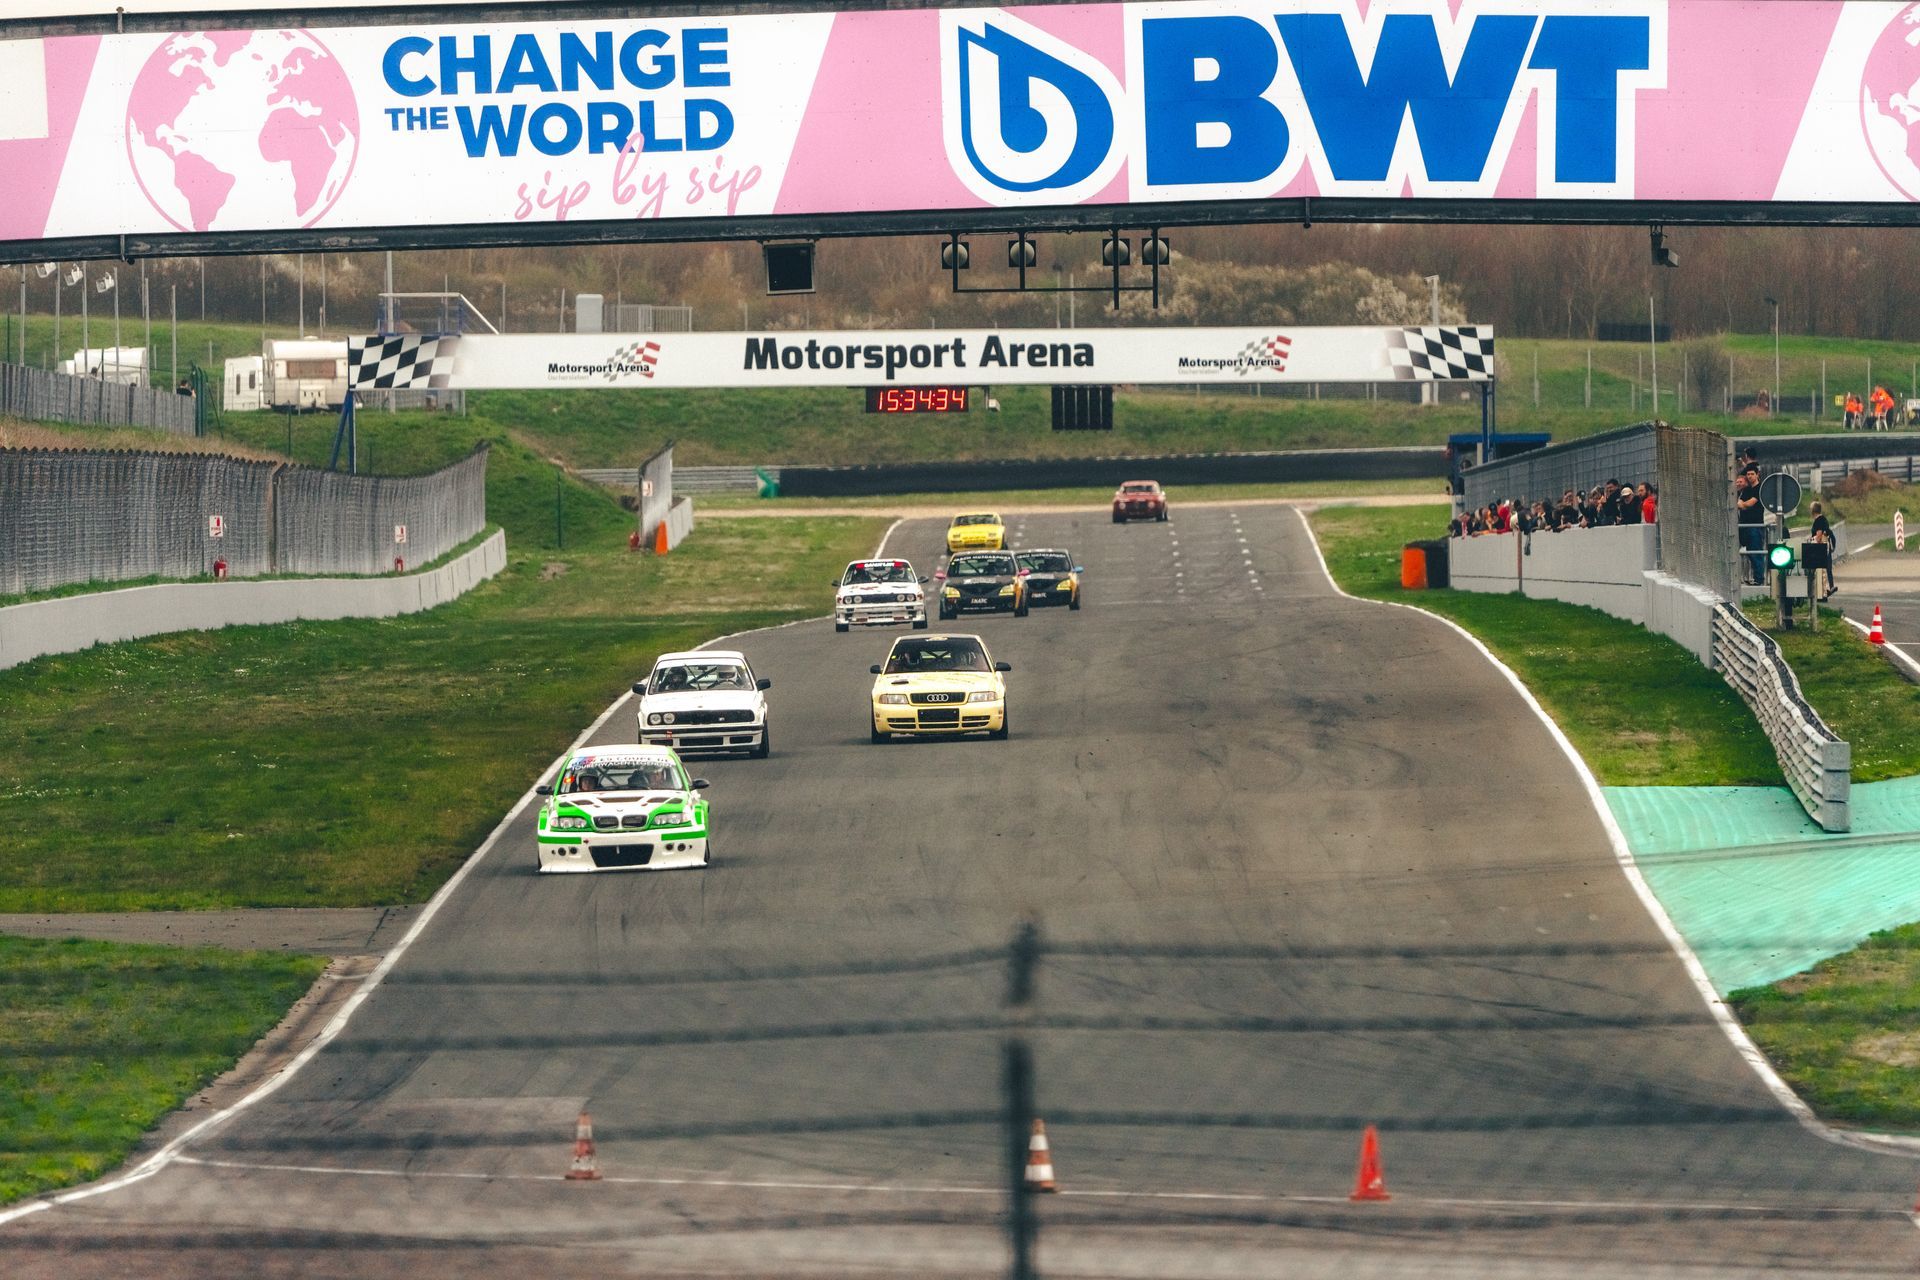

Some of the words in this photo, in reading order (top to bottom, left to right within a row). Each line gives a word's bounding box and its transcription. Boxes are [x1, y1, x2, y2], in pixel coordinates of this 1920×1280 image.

[382, 27, 731, 97] CHANGE
[1143, 13, 1650, 186] BWT
[384, 106, 449, 131] THE
[454, 98, 735, 158] WORLD
[514, 170, 591, 221] sip
[612, 132, 670, 219] by
[686, 155, 762, 216] sip
[548, 363, 613, 375] Motorsport
[616, 362, 650, 373] Arena
[744, 337, 966, 379] Motorsport
[979, 335, 1094, 367] Arena
[1178, 357, 1243, 370] Motorsport
[1247, 357, 1281, 367] Arena
[878, 389, 965, 411] 15:34:34
